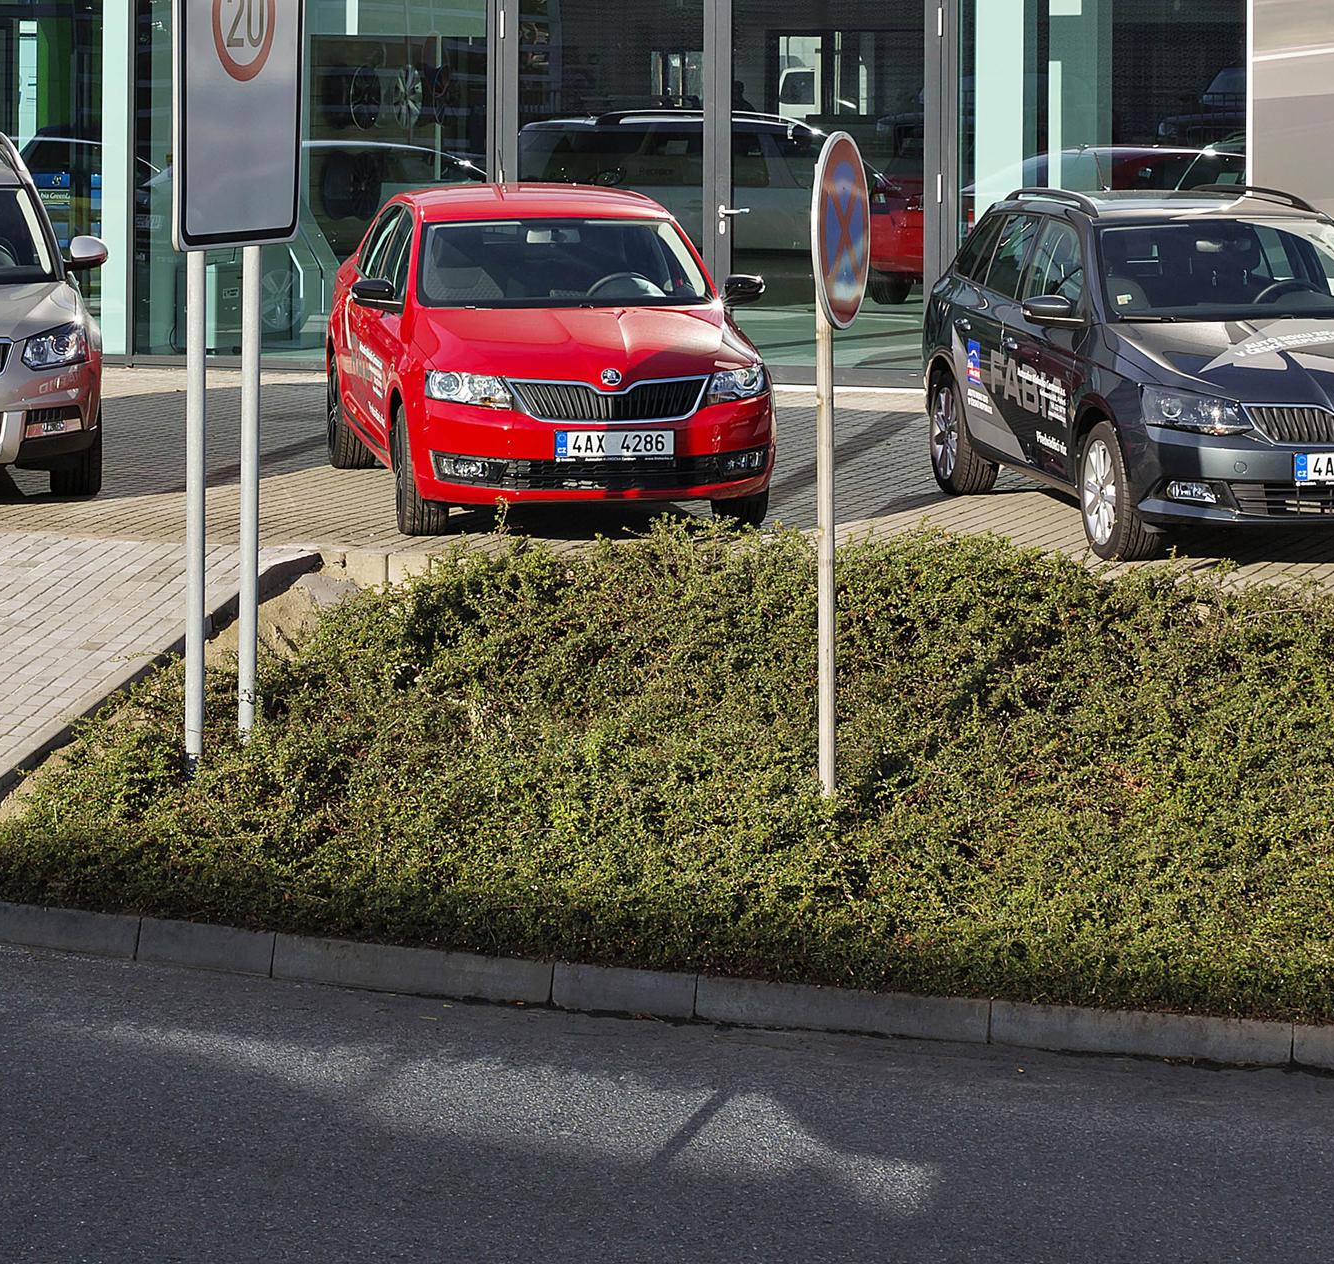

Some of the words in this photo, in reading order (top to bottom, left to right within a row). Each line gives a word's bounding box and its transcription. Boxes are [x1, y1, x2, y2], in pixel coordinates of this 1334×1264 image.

[1244, 337, 1278, 350] AUTO
[572, 434, 606, 453] 4AX
[620, 433, 665, 453] 4286
